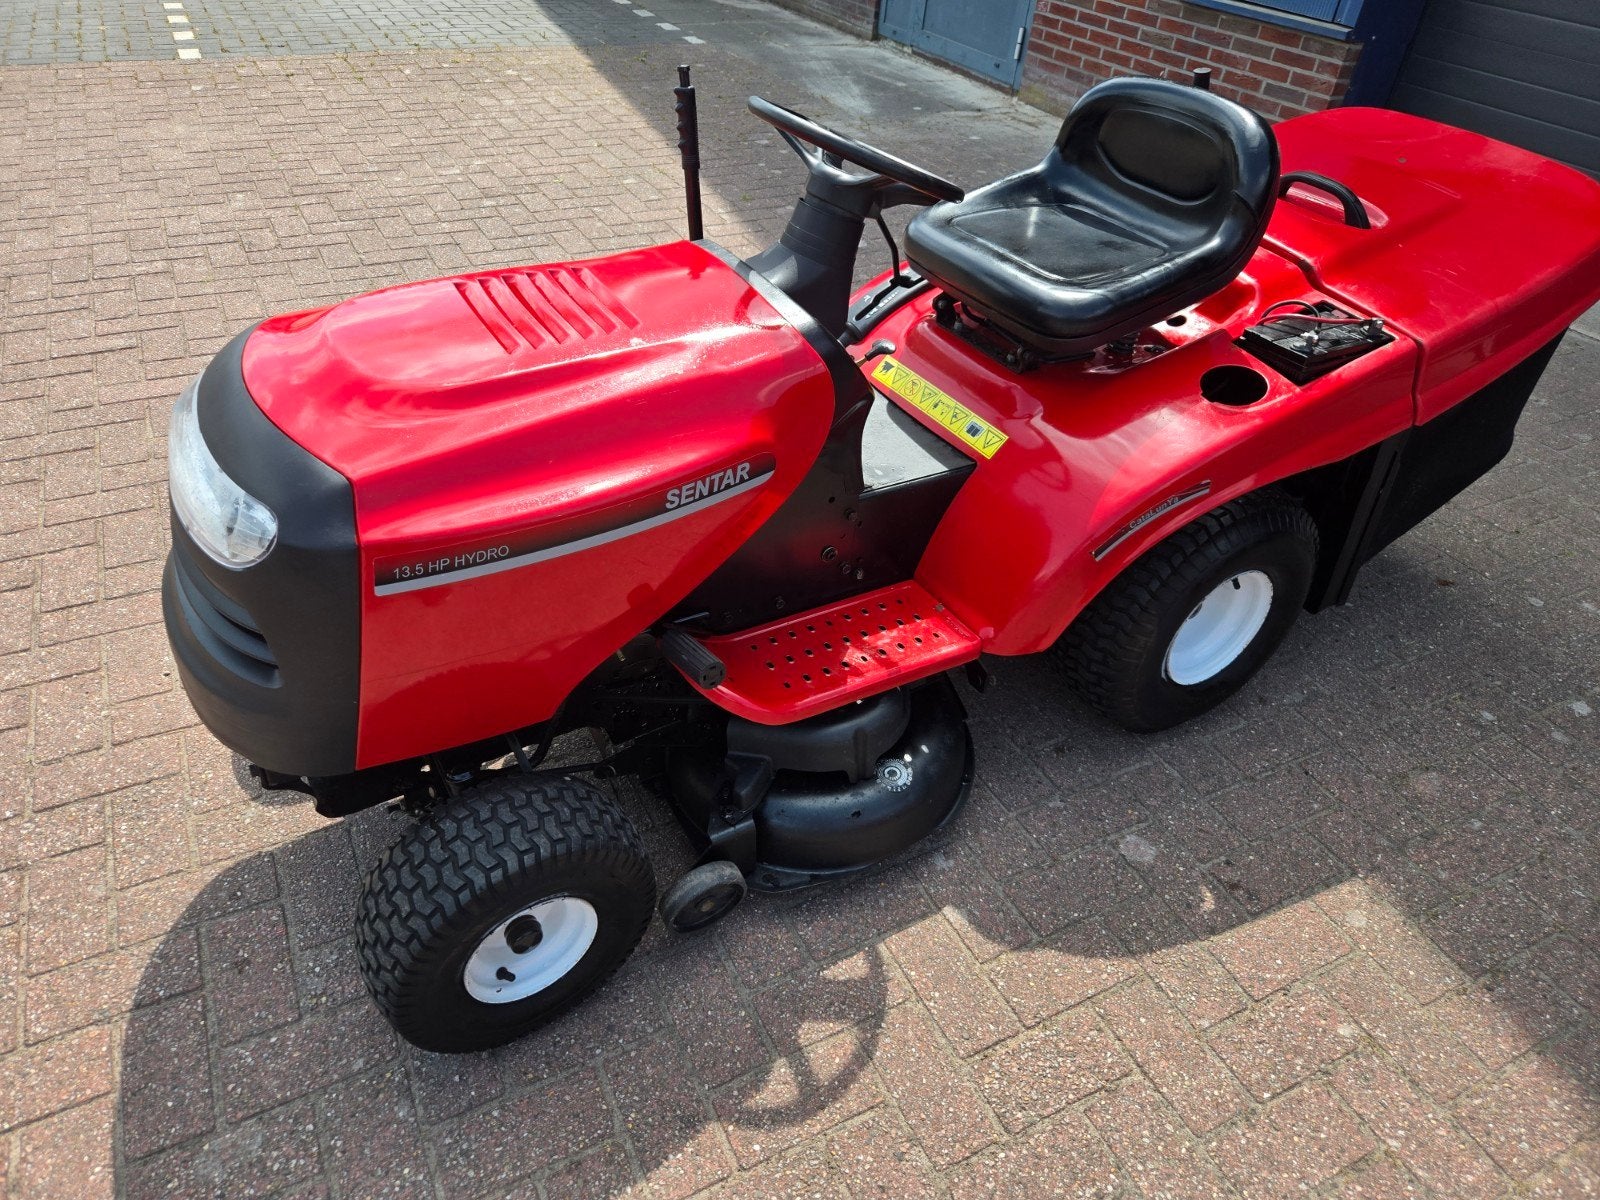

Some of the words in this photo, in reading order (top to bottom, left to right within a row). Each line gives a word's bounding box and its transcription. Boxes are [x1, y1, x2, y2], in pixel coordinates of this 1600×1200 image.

[665, 462, 751, 510] SENTAR
[393, 562, 424, 579] 13.5
[428, 557, 450, 573] HP
[454, 545, 510, 568] HYDRO
